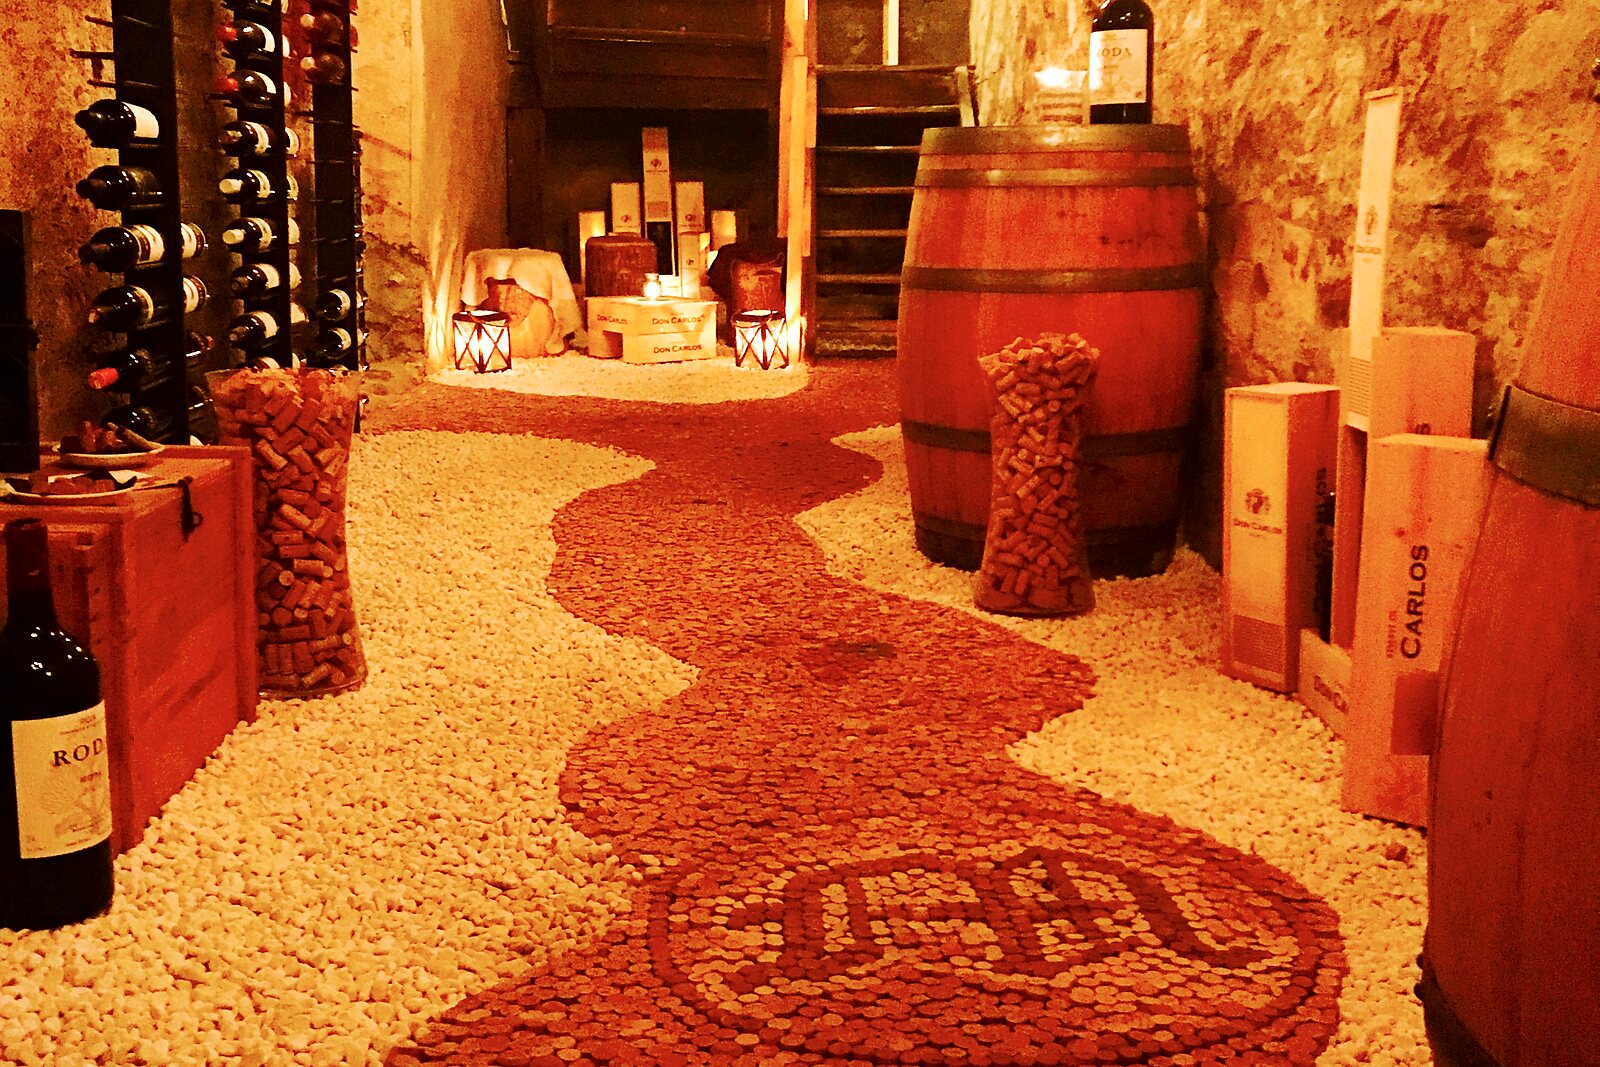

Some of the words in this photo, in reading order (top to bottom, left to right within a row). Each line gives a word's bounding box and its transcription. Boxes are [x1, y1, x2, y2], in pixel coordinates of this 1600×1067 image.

[1097, 47, 1132, 57] ODA
[652, 317, 669, 325] DON
[671, 316, 702, 324] CARLOS
[653, 346, 670, 354] DON
[672, 344, 702, 352] CARLOS
[1400, 545, 1429, 659] CARLOS
[52, 738, 103, 767] ROD
